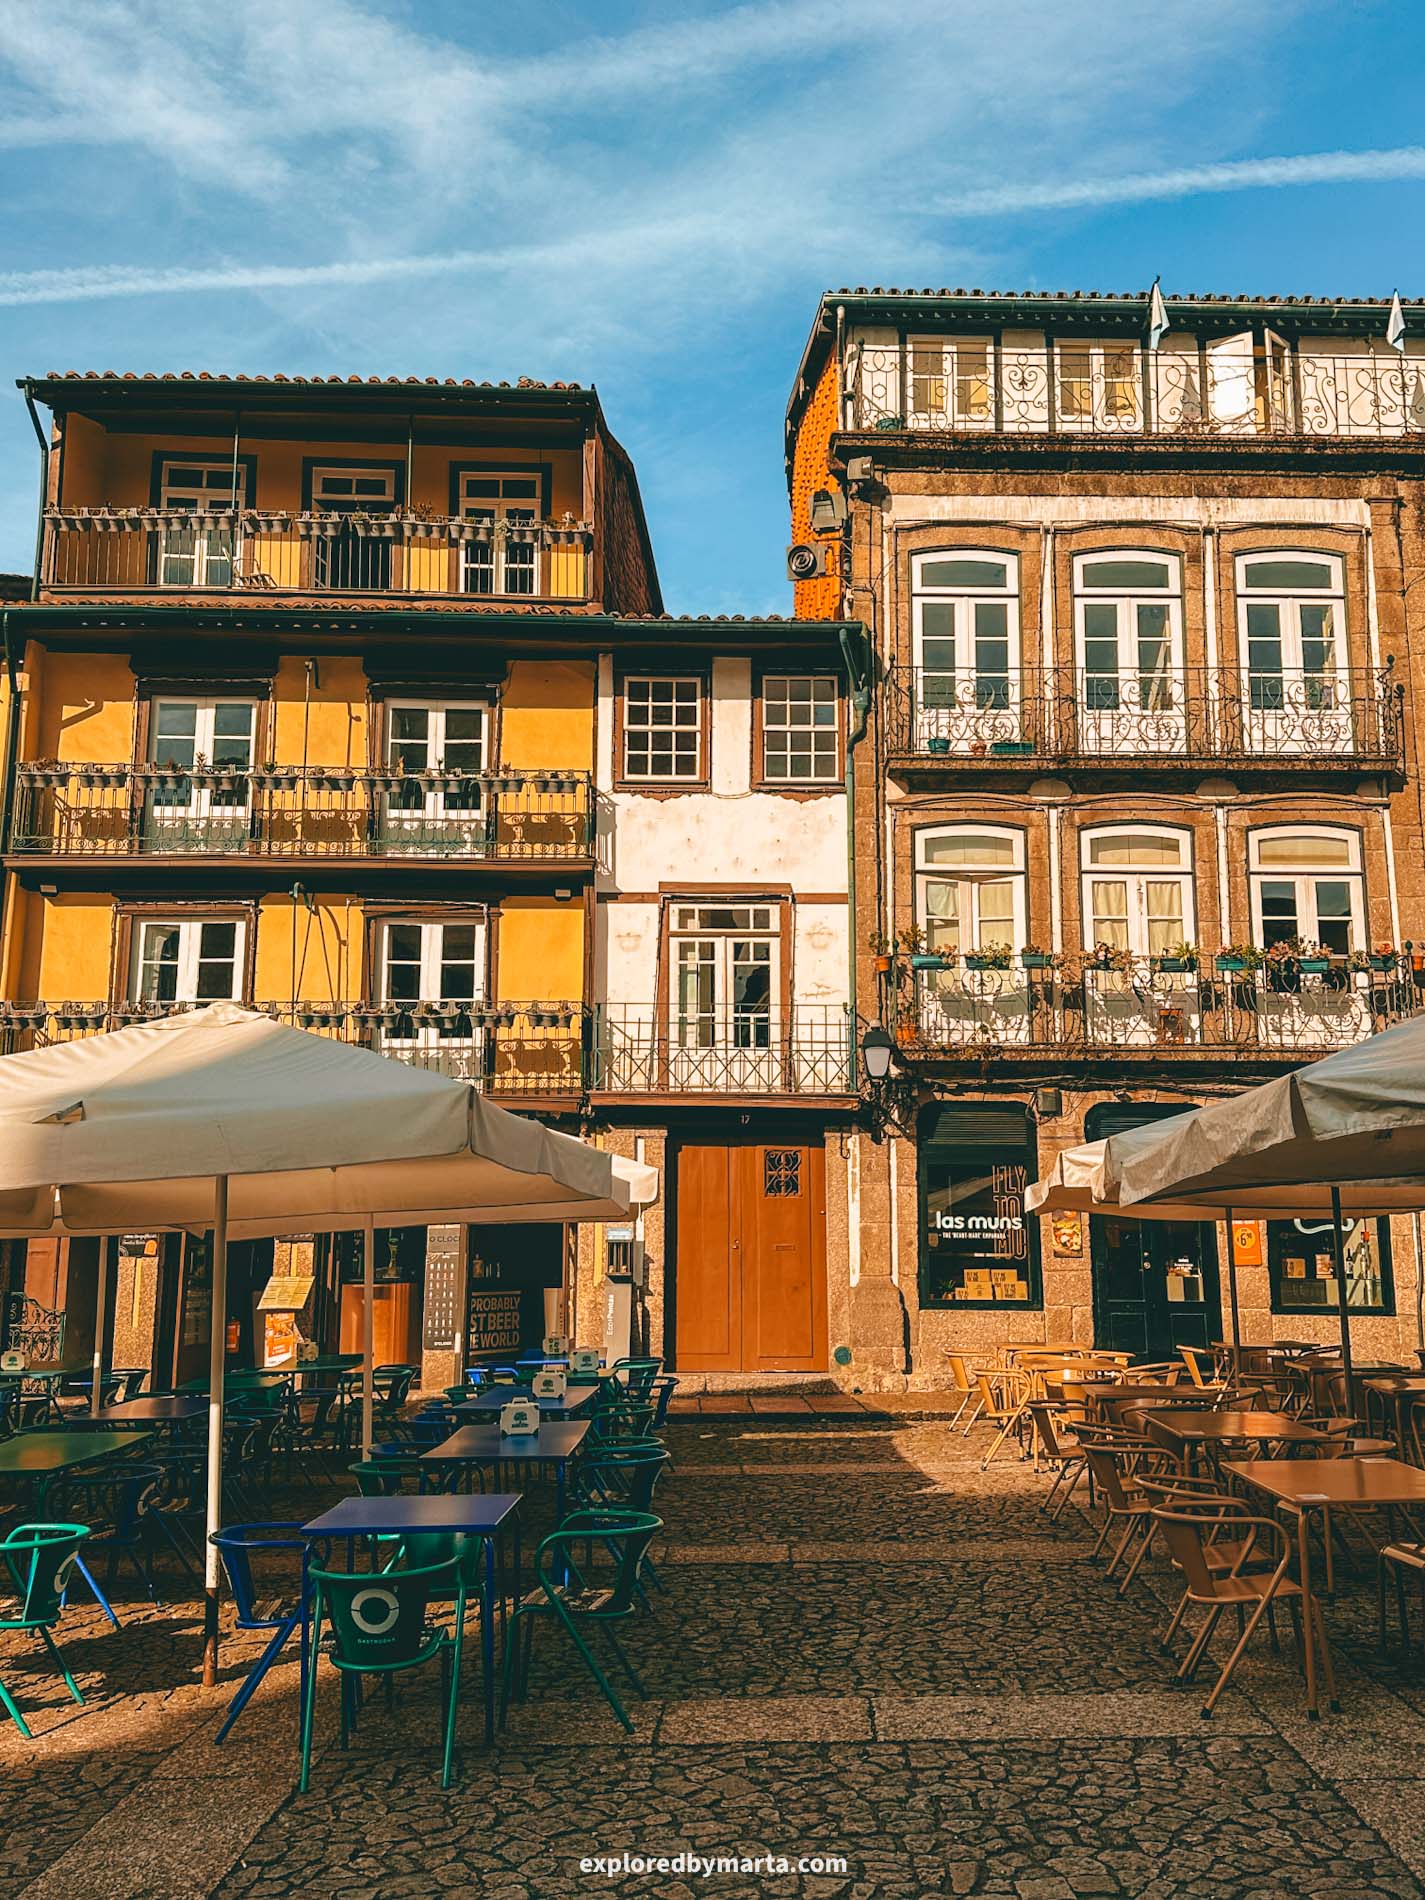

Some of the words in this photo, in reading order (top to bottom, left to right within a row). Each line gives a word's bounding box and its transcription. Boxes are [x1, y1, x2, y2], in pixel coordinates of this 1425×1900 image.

[992, 1165, 1027, 1193] FLY
[935, 1210, 965, 1229] las
[967, 1215, 1023, 1230] muns
[471, 1296, 520, 1312] PROBABLY
[470, 1312, 487, 1332] ST
[487, 1311, 520, 1330] BEER
[480, 1331, 520, 1348] WORLD
